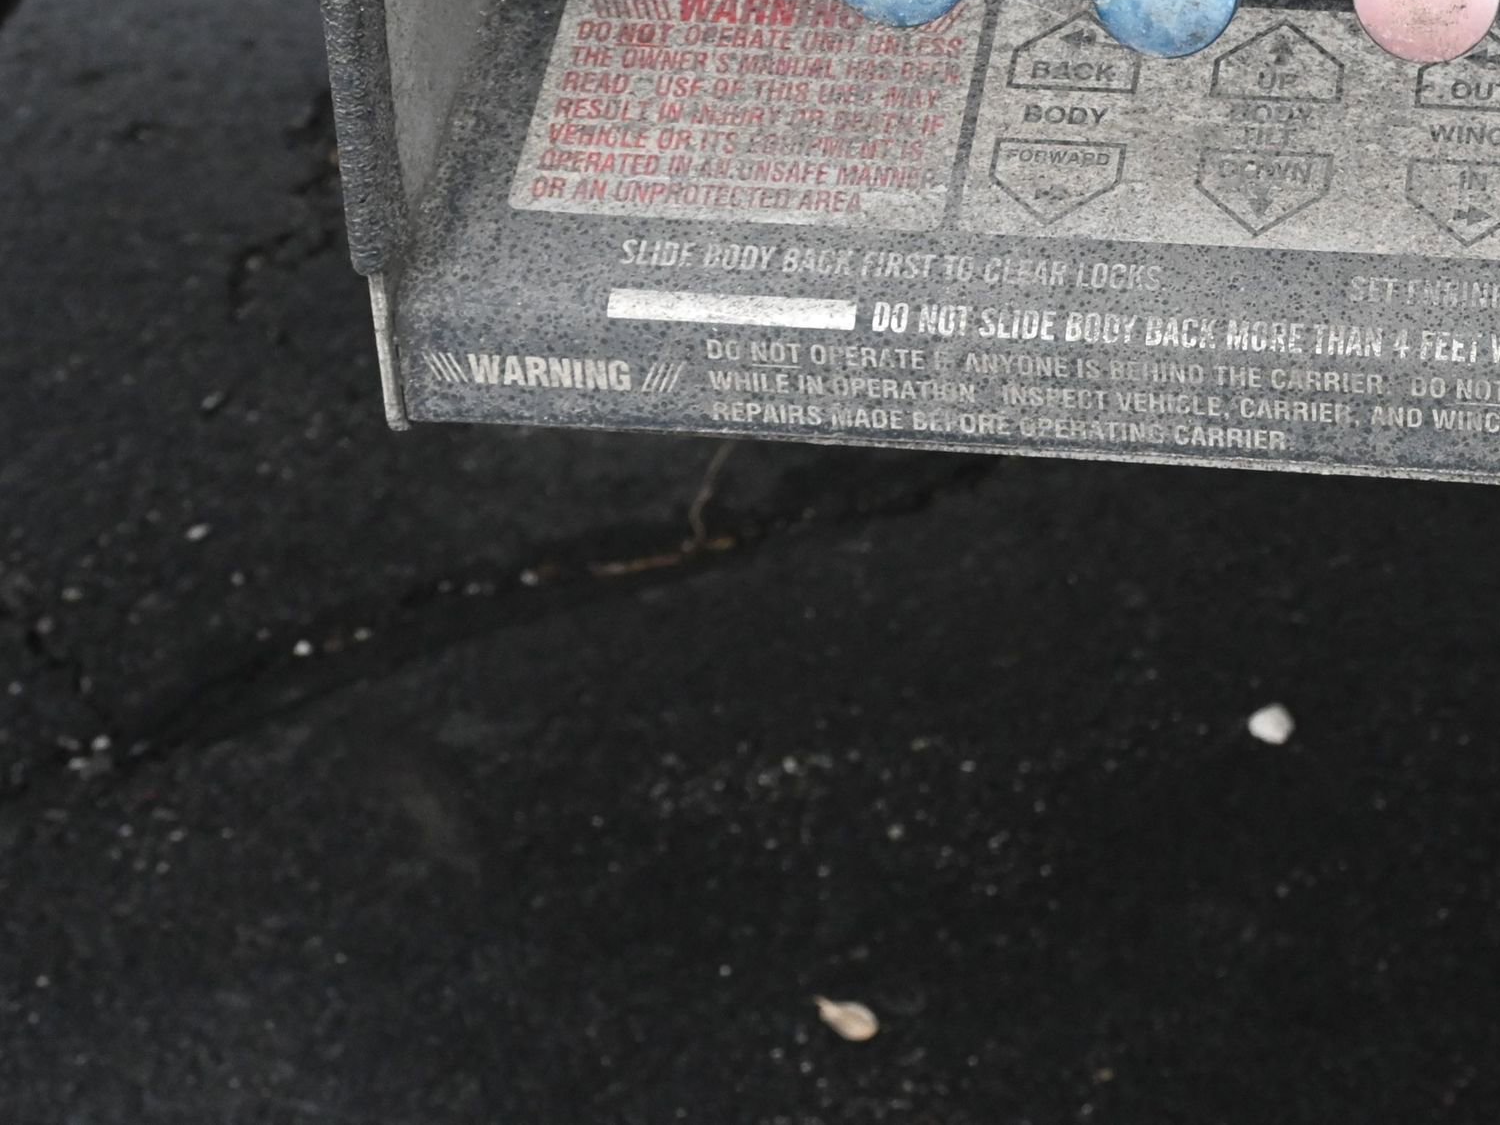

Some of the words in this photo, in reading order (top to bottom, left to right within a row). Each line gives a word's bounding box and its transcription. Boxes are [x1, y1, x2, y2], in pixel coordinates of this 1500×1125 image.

[578, 21, 610, 42] DO
[616, 23, 675, 46] NOT
[684, 25, 792, 51] OPERATE
[572, 46, 612, 67] THE
[655, 75, 704, 98] USE
[713, 78, 744, 100] OF
[1256, 71, 1298, 92] UP
[554, 97, 650, 122] RESULT
[658, 101, 684, 123] IN
[1022, 104, 1109, 125] BODY
[549, 123, 650, 149] VEHICLE
[657, 127, 693, 151] OR
[537, 150, 661, 176] OPERATED
[668, 154, 693, 175] IN
[531, 175, 565, 199] OR
[571, 178, 609, 200] AN
[1458, 170, 1488, 190] IN
[620, 238, 696, 267] SLIDE
[702, 242, 777, 271] BODY
[872, 301, 909, 333] DO
[918, 304, 973, 337] NOT
[978, 308, 1055, 341] SLIDE
[1065, 311, 1139, 344] BODY
[1145, 315, 1217, 349] BACK
[1226, 319, 1305, 354] MORE
[1312, 324, 1383, 358] THAN
[467, 353, 632, 391] WARNING
[705, 338, 741, 360] DO
[750, 342, 801, 366] NOT
[810, 344, 926, 370] OPERATE
[965, 352, 1068, 377] ANYONE
[1077, 358, 1101, 379] IS
[1215, 365, 1262, 388] THE
[1411, 377, 1447, 400] DO
[708, 369, 789, 394] WHILE
[799, 373, 823, 396] IN
[1002, 384, 1108, 411] INSPECT
[1370, 405, 1423, 429] AND
[712, 401, 823, 427] REPAIRS
[831, 406, 904, 431] MADE
